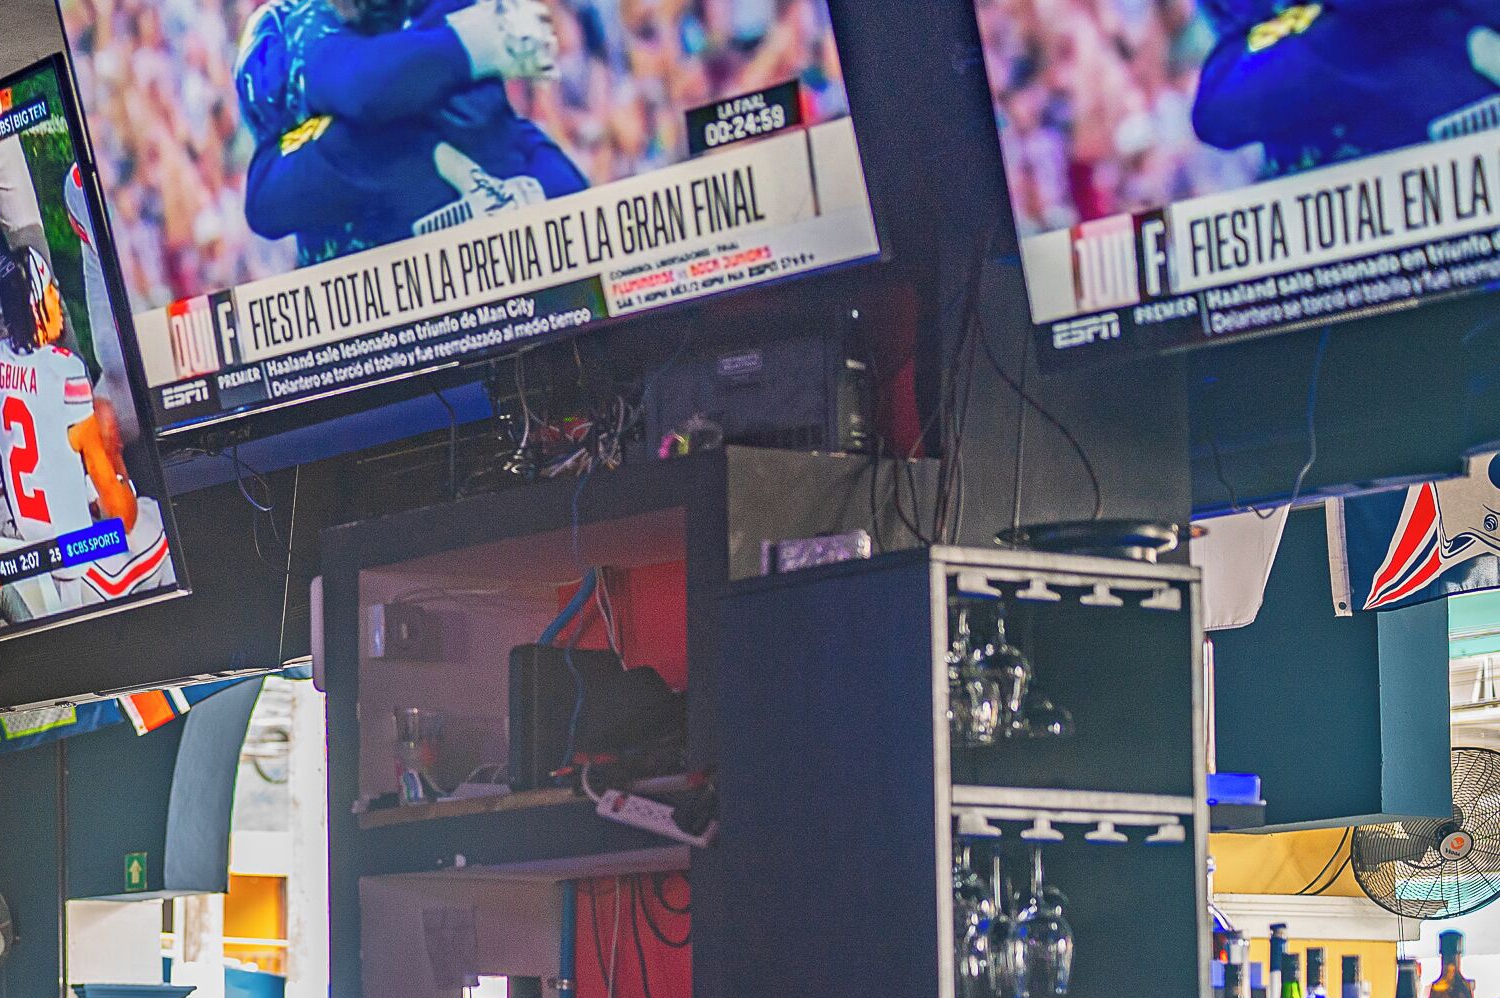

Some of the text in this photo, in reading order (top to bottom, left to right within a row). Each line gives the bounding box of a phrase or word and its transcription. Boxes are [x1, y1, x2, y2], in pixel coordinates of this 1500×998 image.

[13, 110, 29, 129] BIG
[28, 101, 47, 121] TEN
[704, 103, 785, 147] 00:24:59
[1190, 202, 1289, 277] FIESTA
[1296, 177, 1393, 253] TOTAL
[1402, 164, 1443, 230] EN
[1452, 155, 1492, 220] LA
[249, 285, 321, 350] FIESTA
[320, 266, 391, 331] TOTAL
[391, 255, 424, 313] EN
[424, 248, 457, 304] LA
[458, 225, 542, 296] PREVIA
[546, 215, 578, 273] DE
[580, 206, 614, 264] LA
[617, 185, 687, 256] GRAN
[691, 166, 766, 237] FINAL
[267, 297, 535, 377] Haaland sale lesionado en triunfo de Man City
[1052, 312, 1121, 350] ESPN
[272, 374, 321, 398] Delantero
[321, 373, 334, 386] se
[364, 360, 374, 375] el
[375, 353, 408, 372] tobillo
[415, 345, 433, 362] fue
[434, 328, 502, 358] reemplazado
[503, 324, 515, 340] al
[515, 317, 550, 337] medio
[550, 307, 592, 330] tiempo
[162, 379, 210, 410] ESPN
[218, 367, 262, 390] PREMIER
[2, 396, 52, 524] 2
[0, 559, 18, 577] 4TH
[19, 551, 40, 572] 2:07
[49, 547, 62, 563] 25
[73, 531, 120, 556] CBS SPORTS
